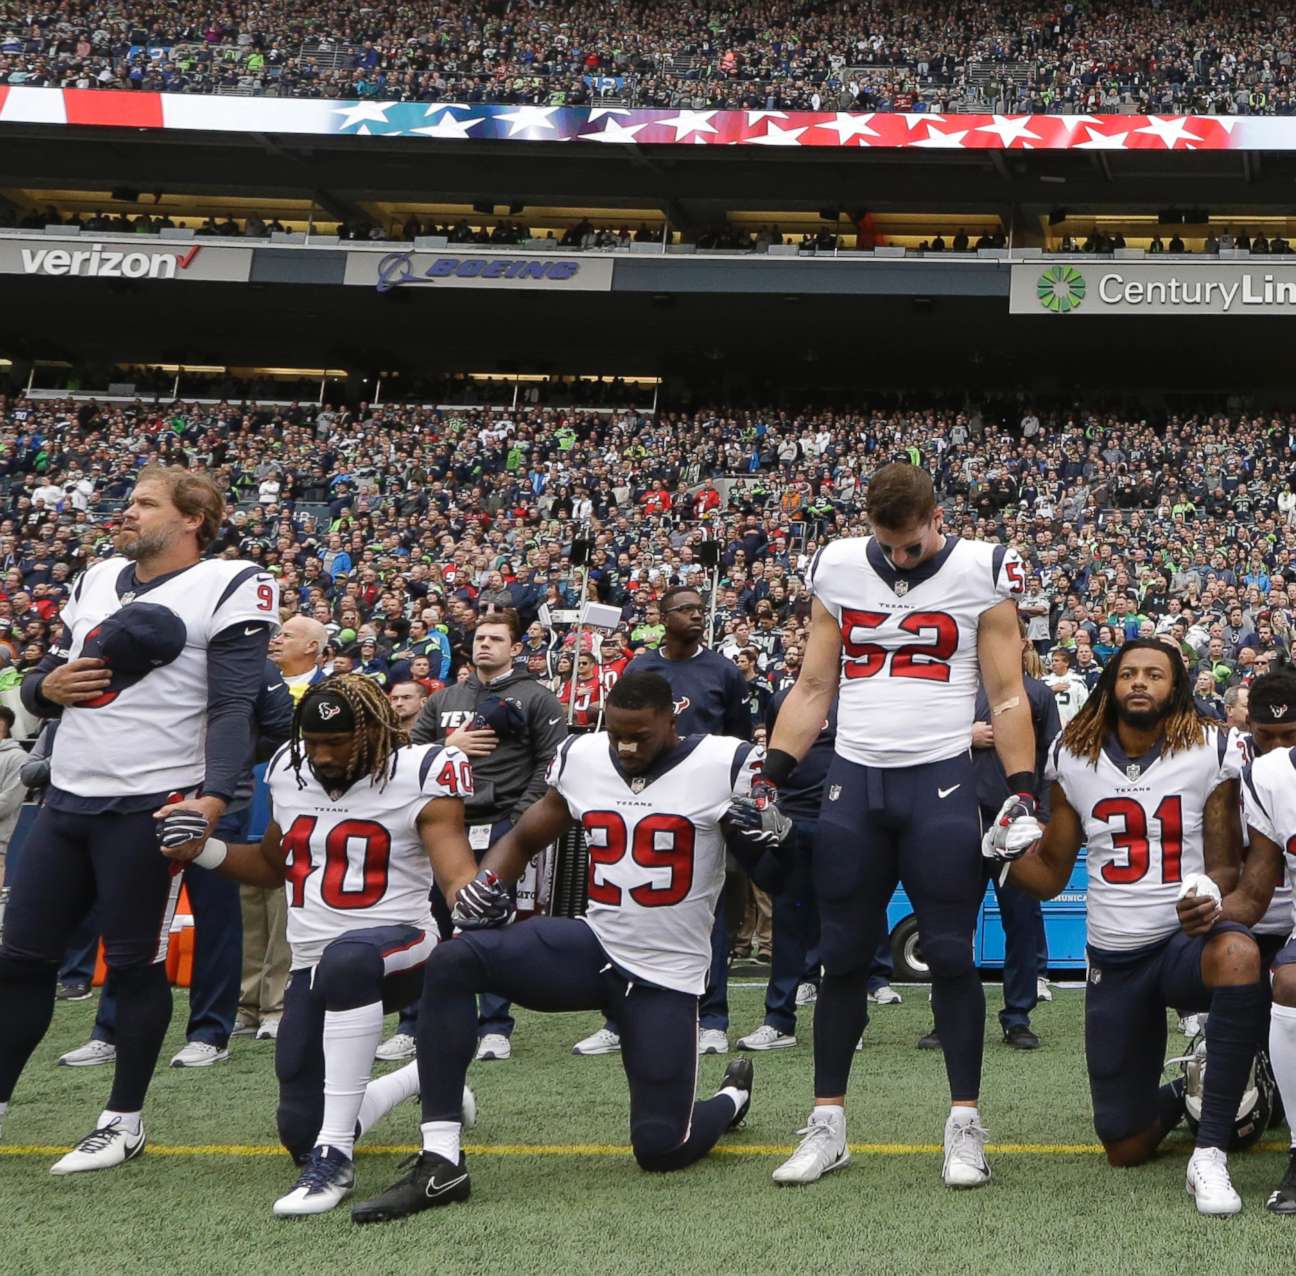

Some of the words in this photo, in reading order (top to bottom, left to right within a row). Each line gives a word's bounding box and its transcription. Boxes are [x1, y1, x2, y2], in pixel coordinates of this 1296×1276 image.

[21, 243, 177, 279] verizon
[425, 258, 579, 280] BOEING
[257, 584, 273, 611] 9
[842, 607, 958, 682] 52
[436, 760, 474, 793] 40
[281, 815, 391, 910] 40
[582, 810, 696, 907] 29
[1091, 795, 1182, 884] 31
